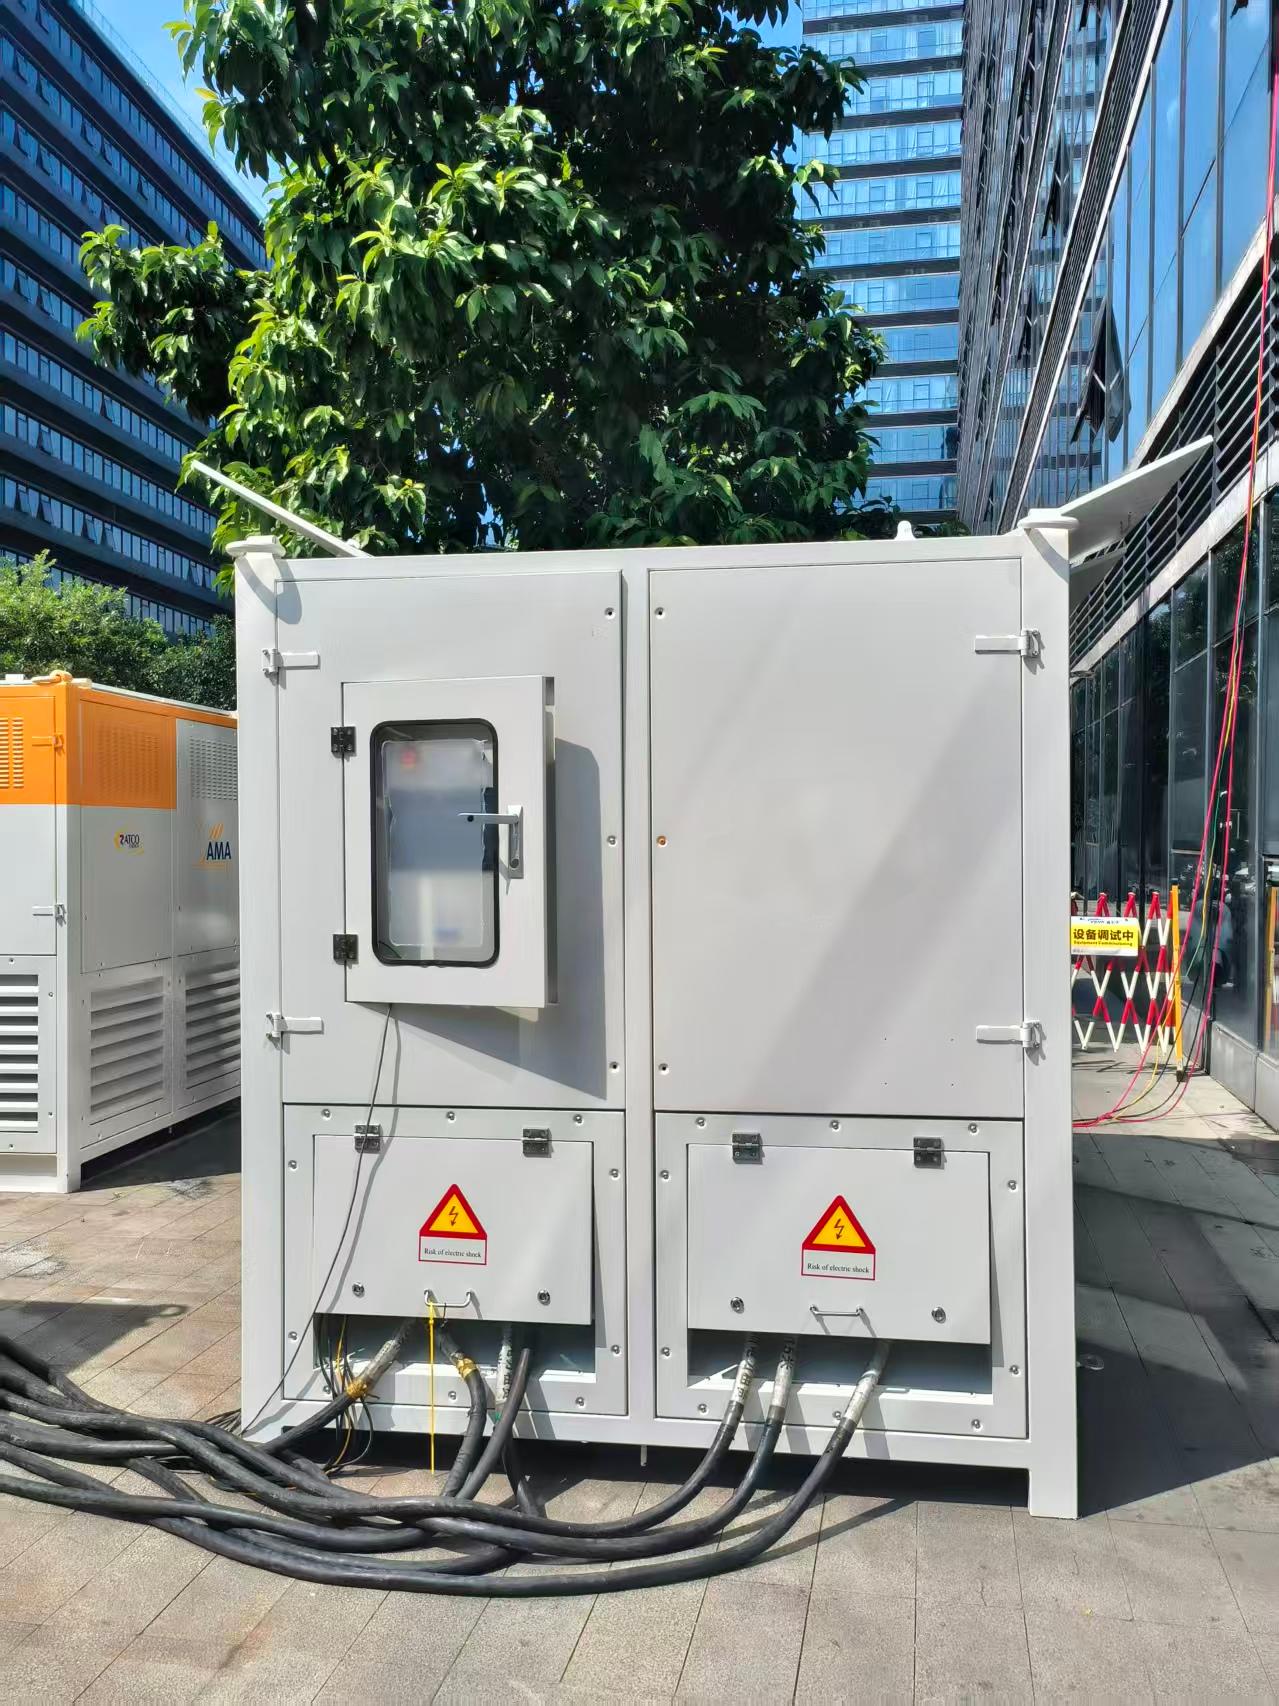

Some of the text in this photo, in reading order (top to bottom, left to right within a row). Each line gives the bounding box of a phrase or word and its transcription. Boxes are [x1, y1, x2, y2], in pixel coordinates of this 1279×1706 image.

[206, 841, 232, 860] AMA
[1073, 928, 1134, 942] 设备调试中
[465, 1250, 482, 1258] shock
